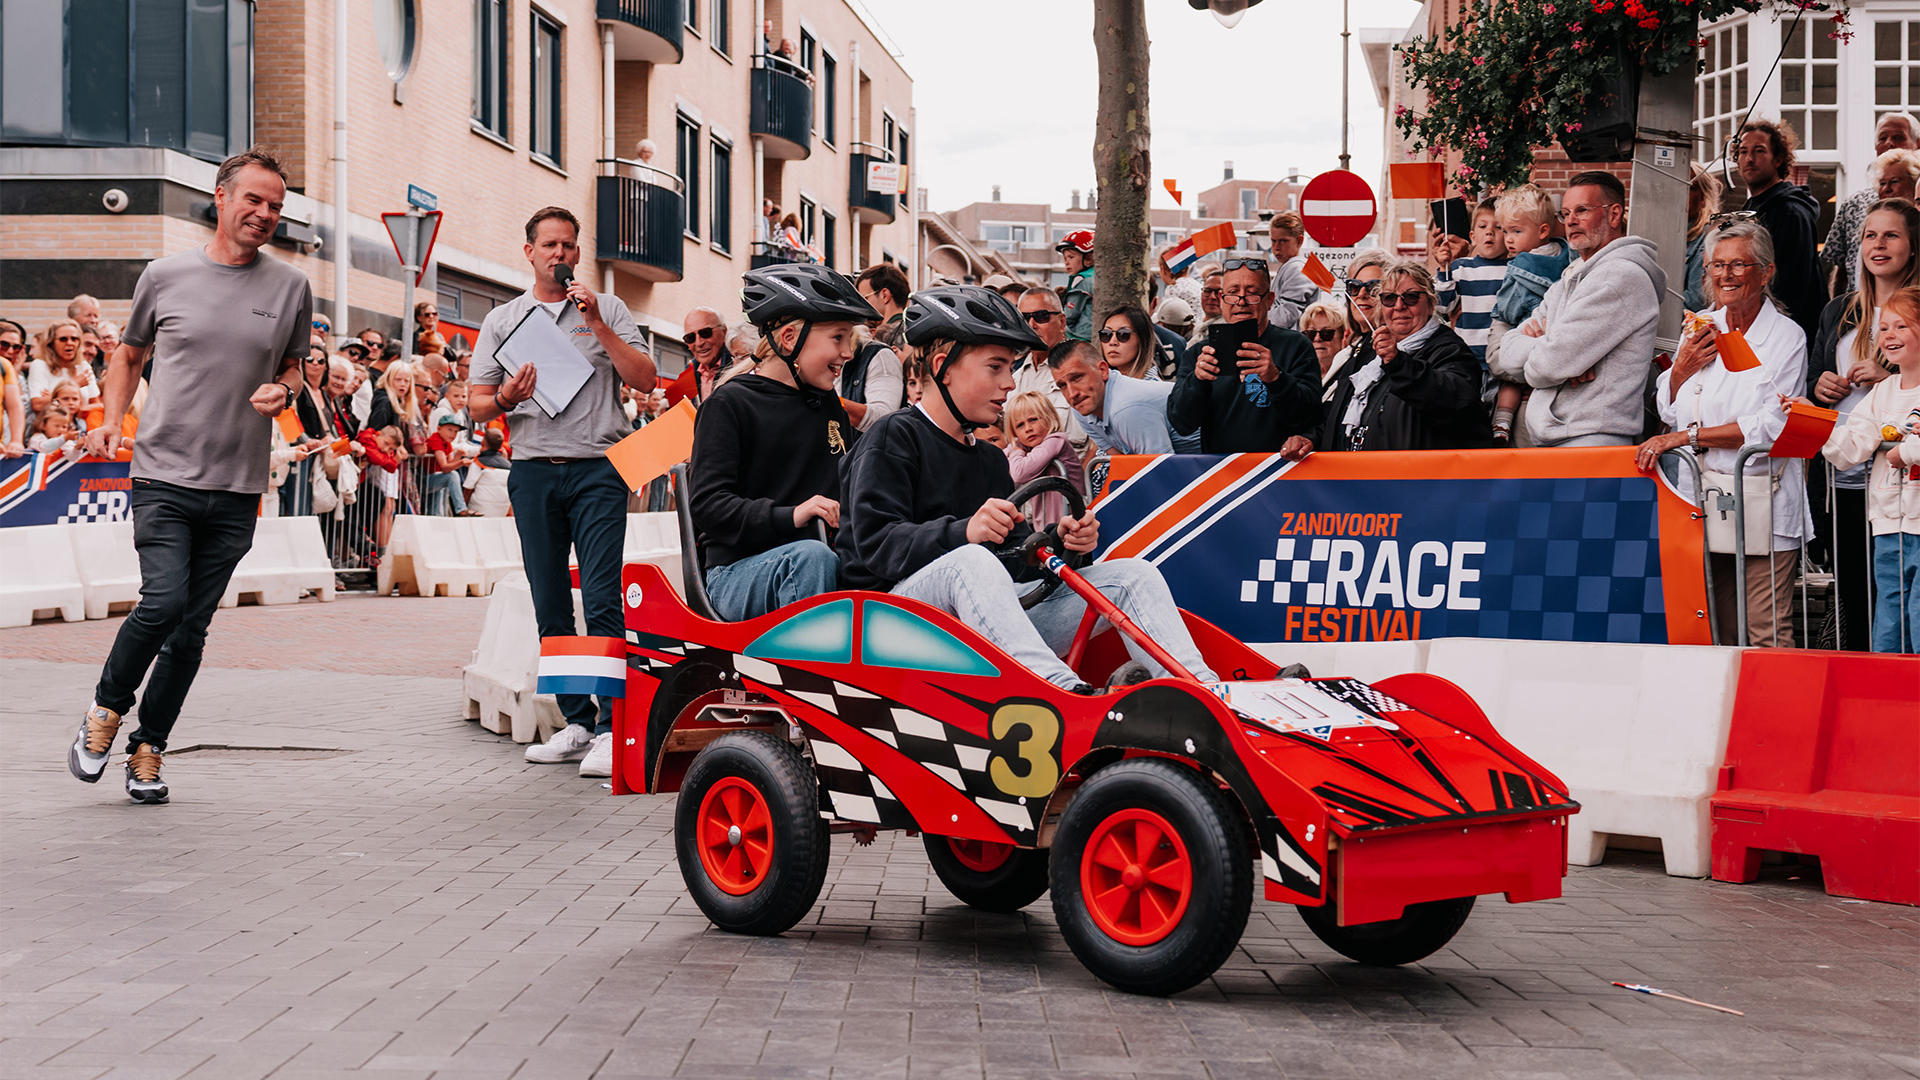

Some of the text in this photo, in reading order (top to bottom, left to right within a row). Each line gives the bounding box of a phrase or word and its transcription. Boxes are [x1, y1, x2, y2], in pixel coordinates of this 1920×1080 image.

[79, 477, 133, 492] ZANDVOO
[1279, 512, 1403, 537] ZANDVOORT
[1325, 539, 1487, 611] RACE
[989, 703, 1060, 799] 3
